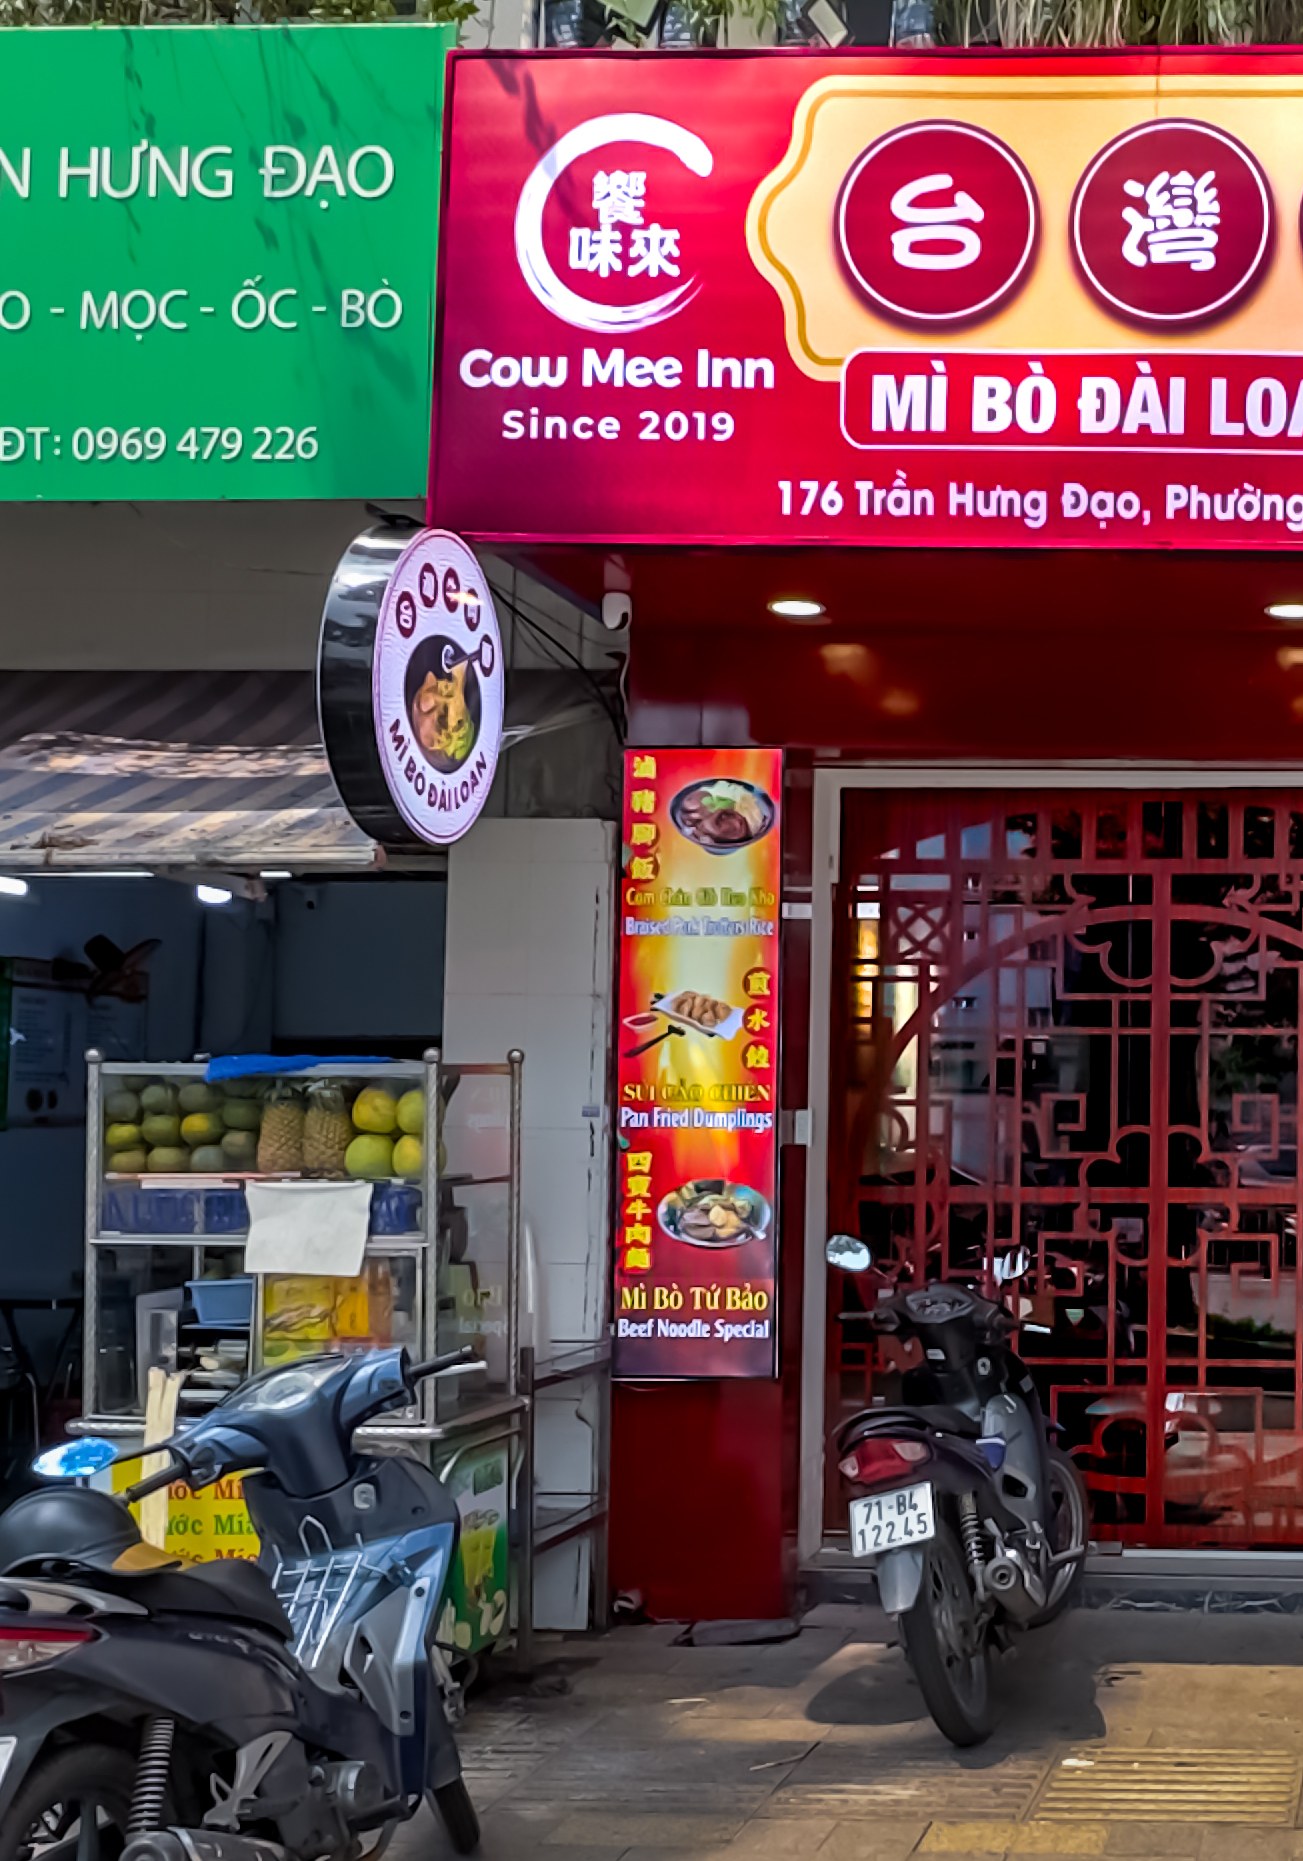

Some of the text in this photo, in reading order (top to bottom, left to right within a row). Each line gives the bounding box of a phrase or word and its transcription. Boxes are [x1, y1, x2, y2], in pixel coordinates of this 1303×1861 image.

[59, 139, 234, 199] HƯNG
[259, 145, 395, 210] ĐẠO
[80, 289, 189, 341] MỌC
[231, 275, 297, 330] ỐC
[340, 279, 403, 329] BÒ
[460, 348, 775, 389] Cow Mee Inn
[871, 361, 947, 432] MÌ
[972, 361, 1057, 434] BÒ
[1077, 362, 1186, 437] ĐÀI
[71, 426, 167, 461] 0969
[176, 426, 243, 461] 479
[251, 426, 319, 461] 226
[502, 407, 735, 441] Since 2019
[778, 481, 844, 516] 176
[856, 470, 935, 516] Trần
[949, 481, 1048, 529] Hưng
[1061, 483, 1150, 530] Đạo,
[389, 718, 487, 812] MÌ BÒ ĐÀI LOAN
[621, 1107, 773, 1134] Pan Fried Dumplings
[621, 1283, 646, 1311] Mì
[654, 1283, 684, 1311] Bò
[726, 1282, 769, 1311] Bảo
[618, 1319, 770, 1342] Beef Noodle Special
[858, 1513, 928, 1552] 122.45
